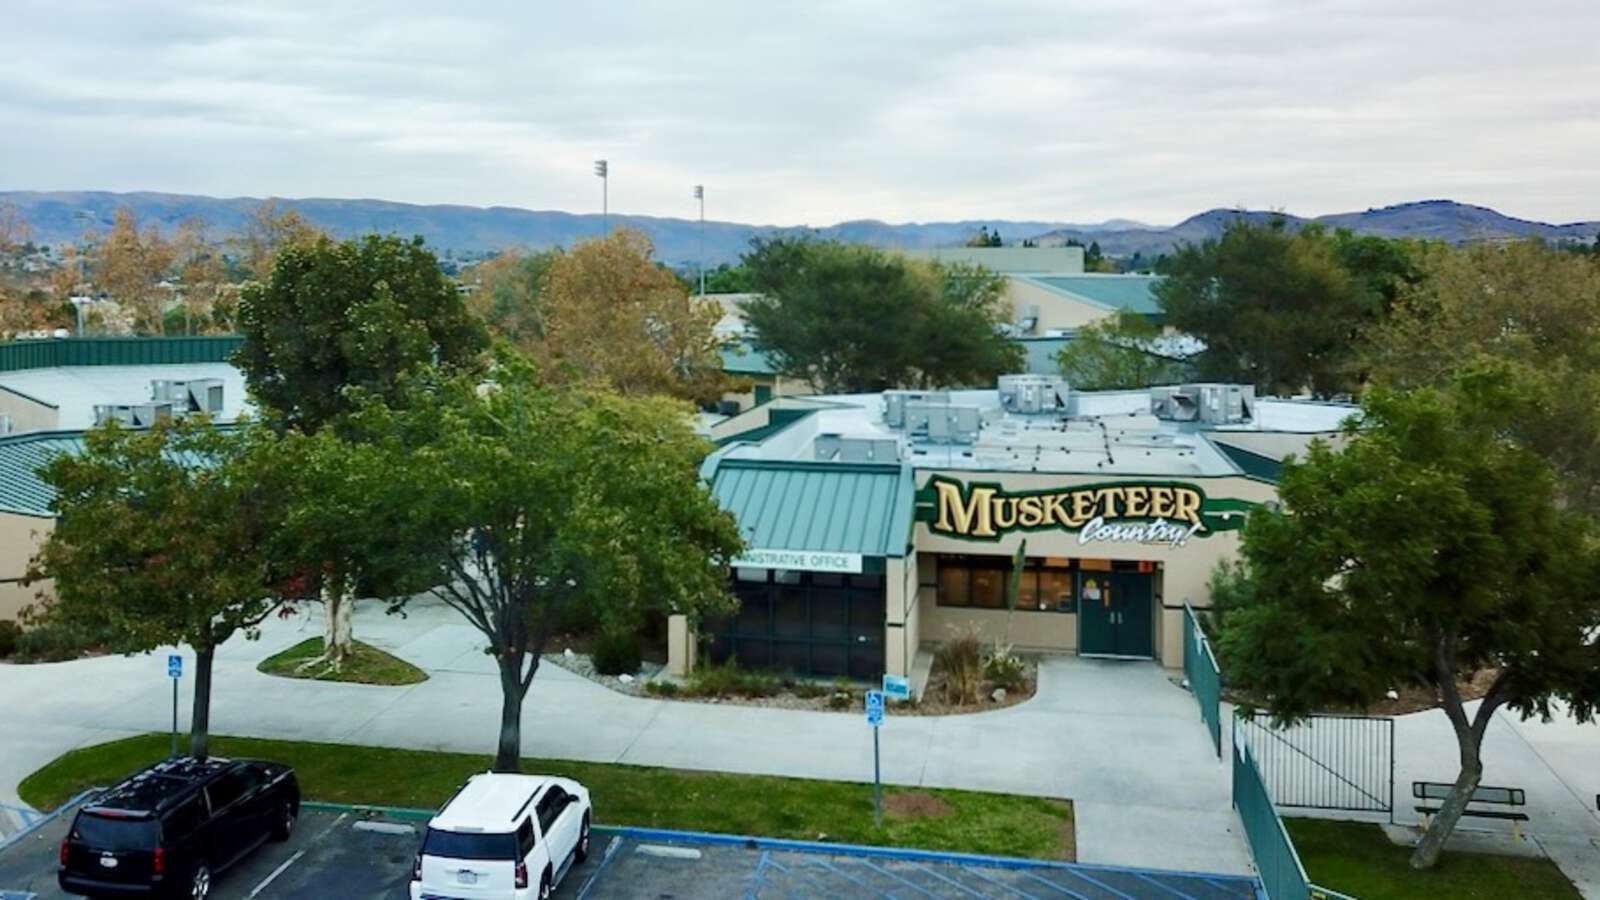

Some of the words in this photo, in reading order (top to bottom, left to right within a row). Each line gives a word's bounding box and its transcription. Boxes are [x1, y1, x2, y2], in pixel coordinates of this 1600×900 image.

[934, 480, 1206, 536] MUSKETEER
[1079, 516, 1201, 549] Country!
[810, 555, 849, 569] OFFICE
